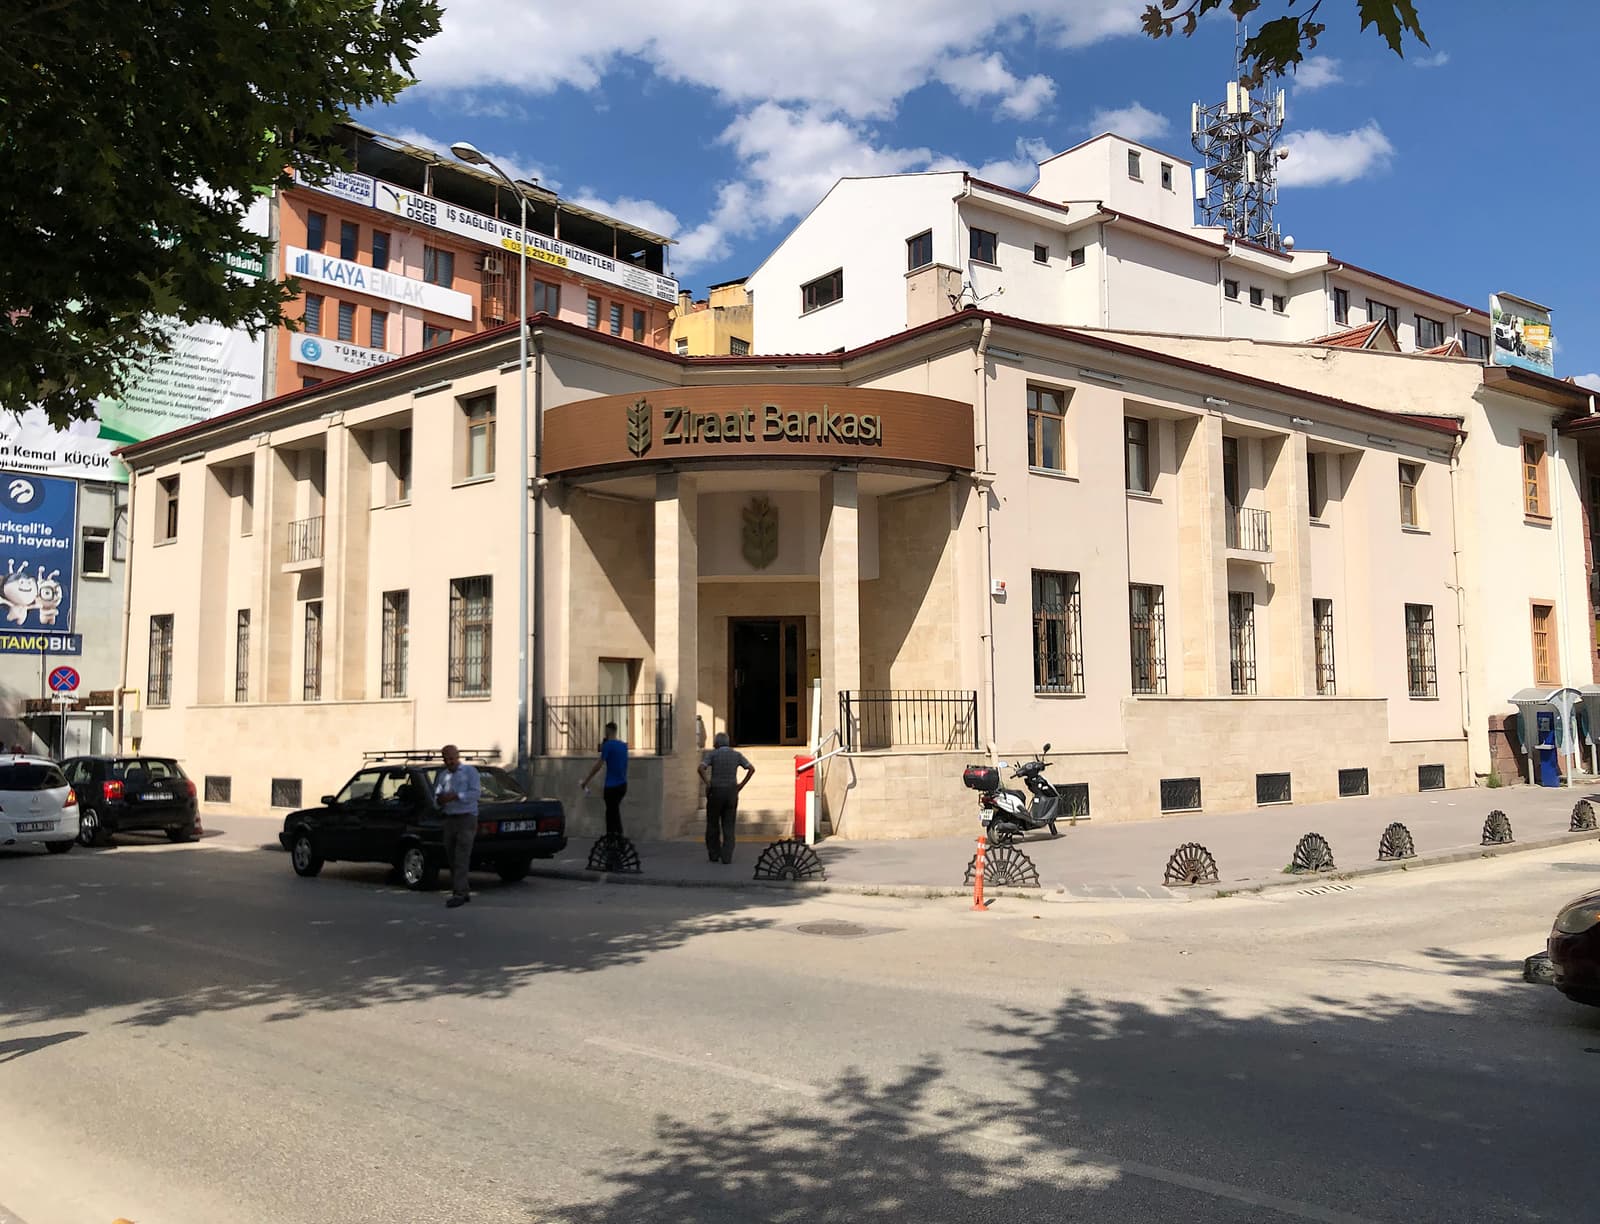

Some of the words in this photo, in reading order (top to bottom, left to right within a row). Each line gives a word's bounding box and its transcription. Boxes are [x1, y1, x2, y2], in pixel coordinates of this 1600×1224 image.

[350, 186, 371, 198] ACAR
[407, 194, 437, 214] LİDER
[407, 208, 437, 225] OSGB
[446, 206, 457, 222] İŞ
[459, 212, 498, 234] SAĞLIĞI
[500, 225, 513, 239] VE
[565, 247, 616, 273] HİZMETLERİ
[511, 241, 532, 255] 036
[532, 247, 546, 260] 212
[546, 252, 556, 262] 77
[322, 258, 366, 289] KAYA
[370, 271, 425, 305] EMLAK
[335, 345, 367, 360] TÜRK
[662, 405, 757, 440] Ziraat
[762, 404, 883, 442] Bankası
[10, 460, 48, 471] Uzmanı
[13, 445, 56, 461] Kemal
[64, 450, 110, 468] KÜÇÜK
[18, 533, 70, 549] hayata!
[0, 635, 76, 651] TAMOBİL
